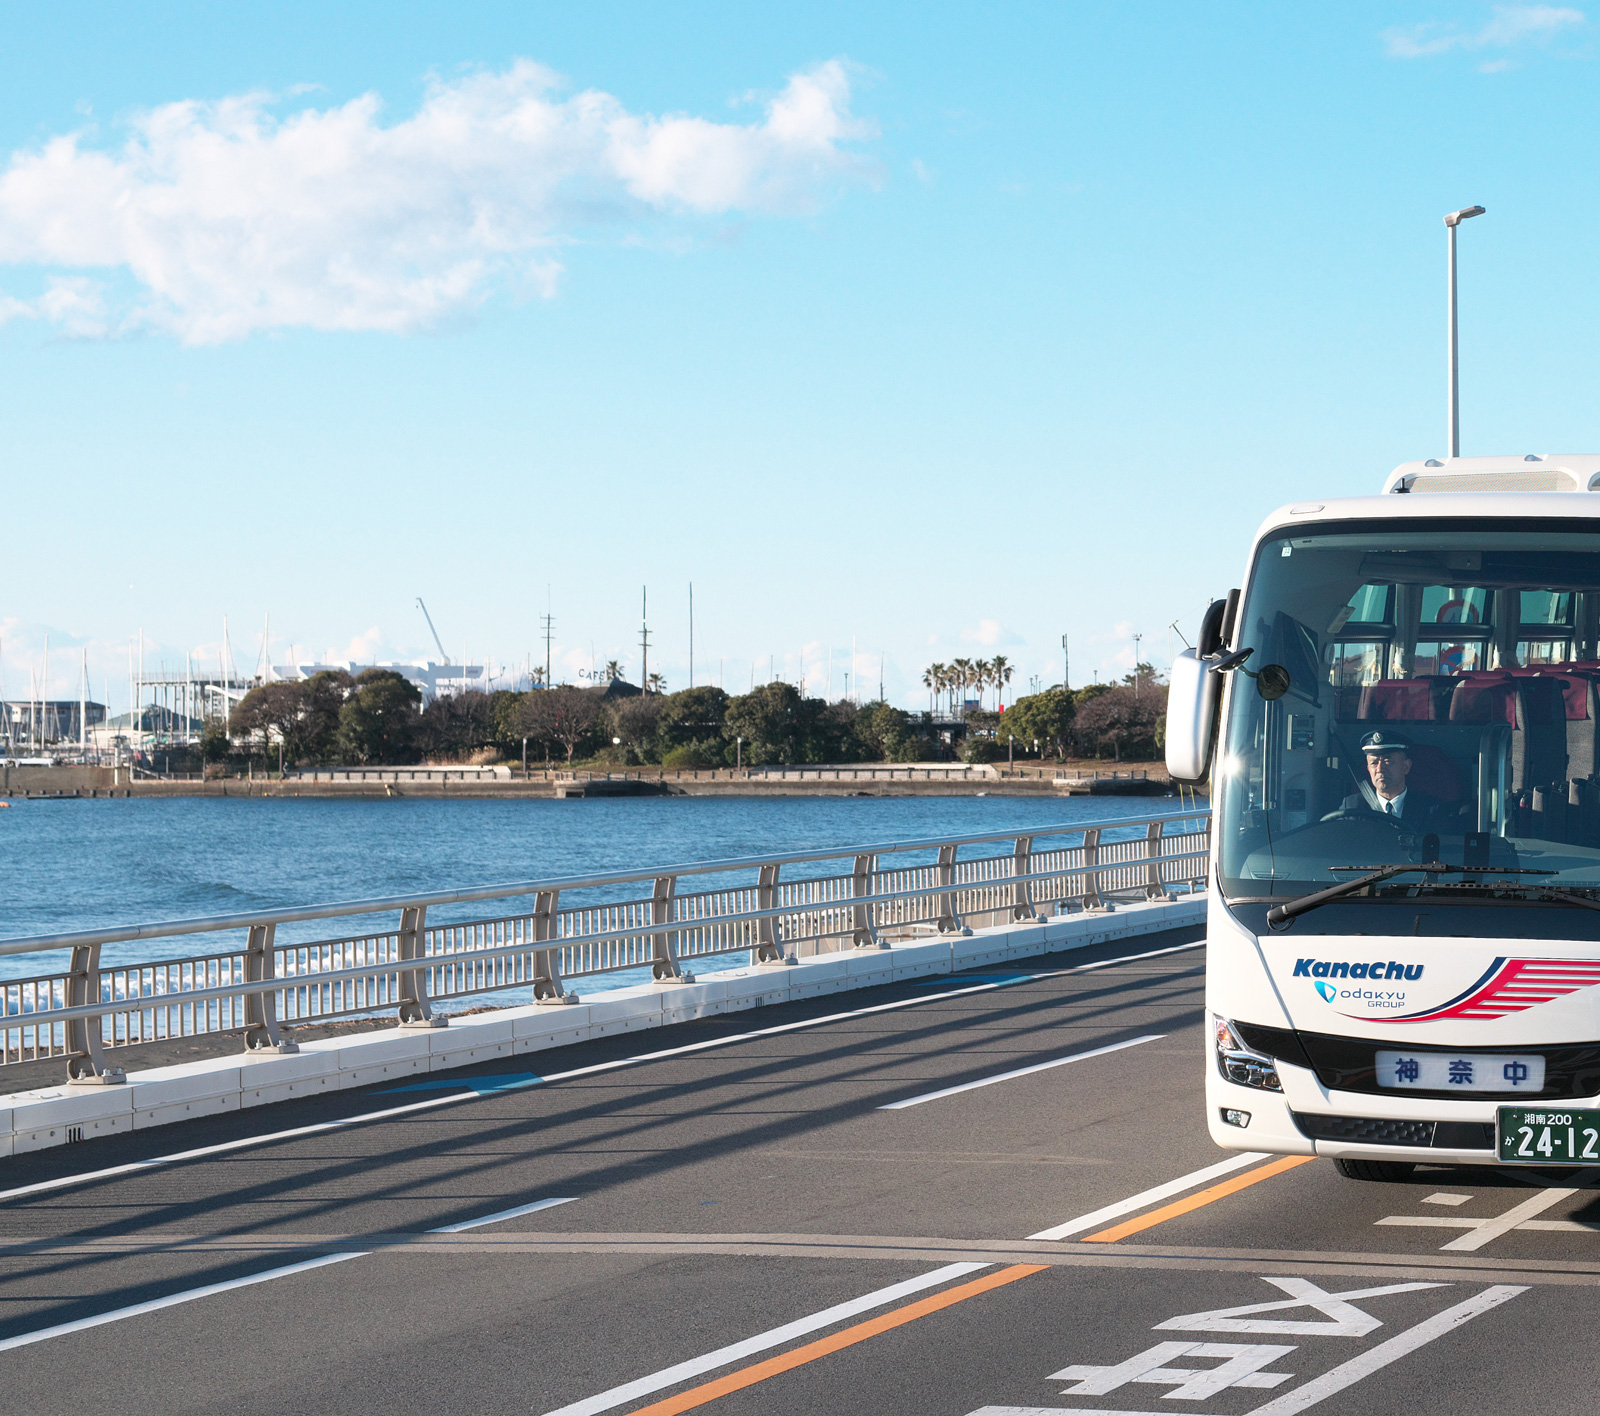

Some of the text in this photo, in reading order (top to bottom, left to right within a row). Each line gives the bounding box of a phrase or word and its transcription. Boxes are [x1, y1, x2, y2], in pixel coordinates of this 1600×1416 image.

[1292, 957, 1425, 981] Kanachu
[1340, 987, 1406, 1000] odakyu
[1367, 1000, 1406, 1009] GROUP
[1394, 1057, 1528, 1086] 神奈中
[1504, 1135, 1516, 1147] か
[1517, 1125, 1599, 1159] 24-12
